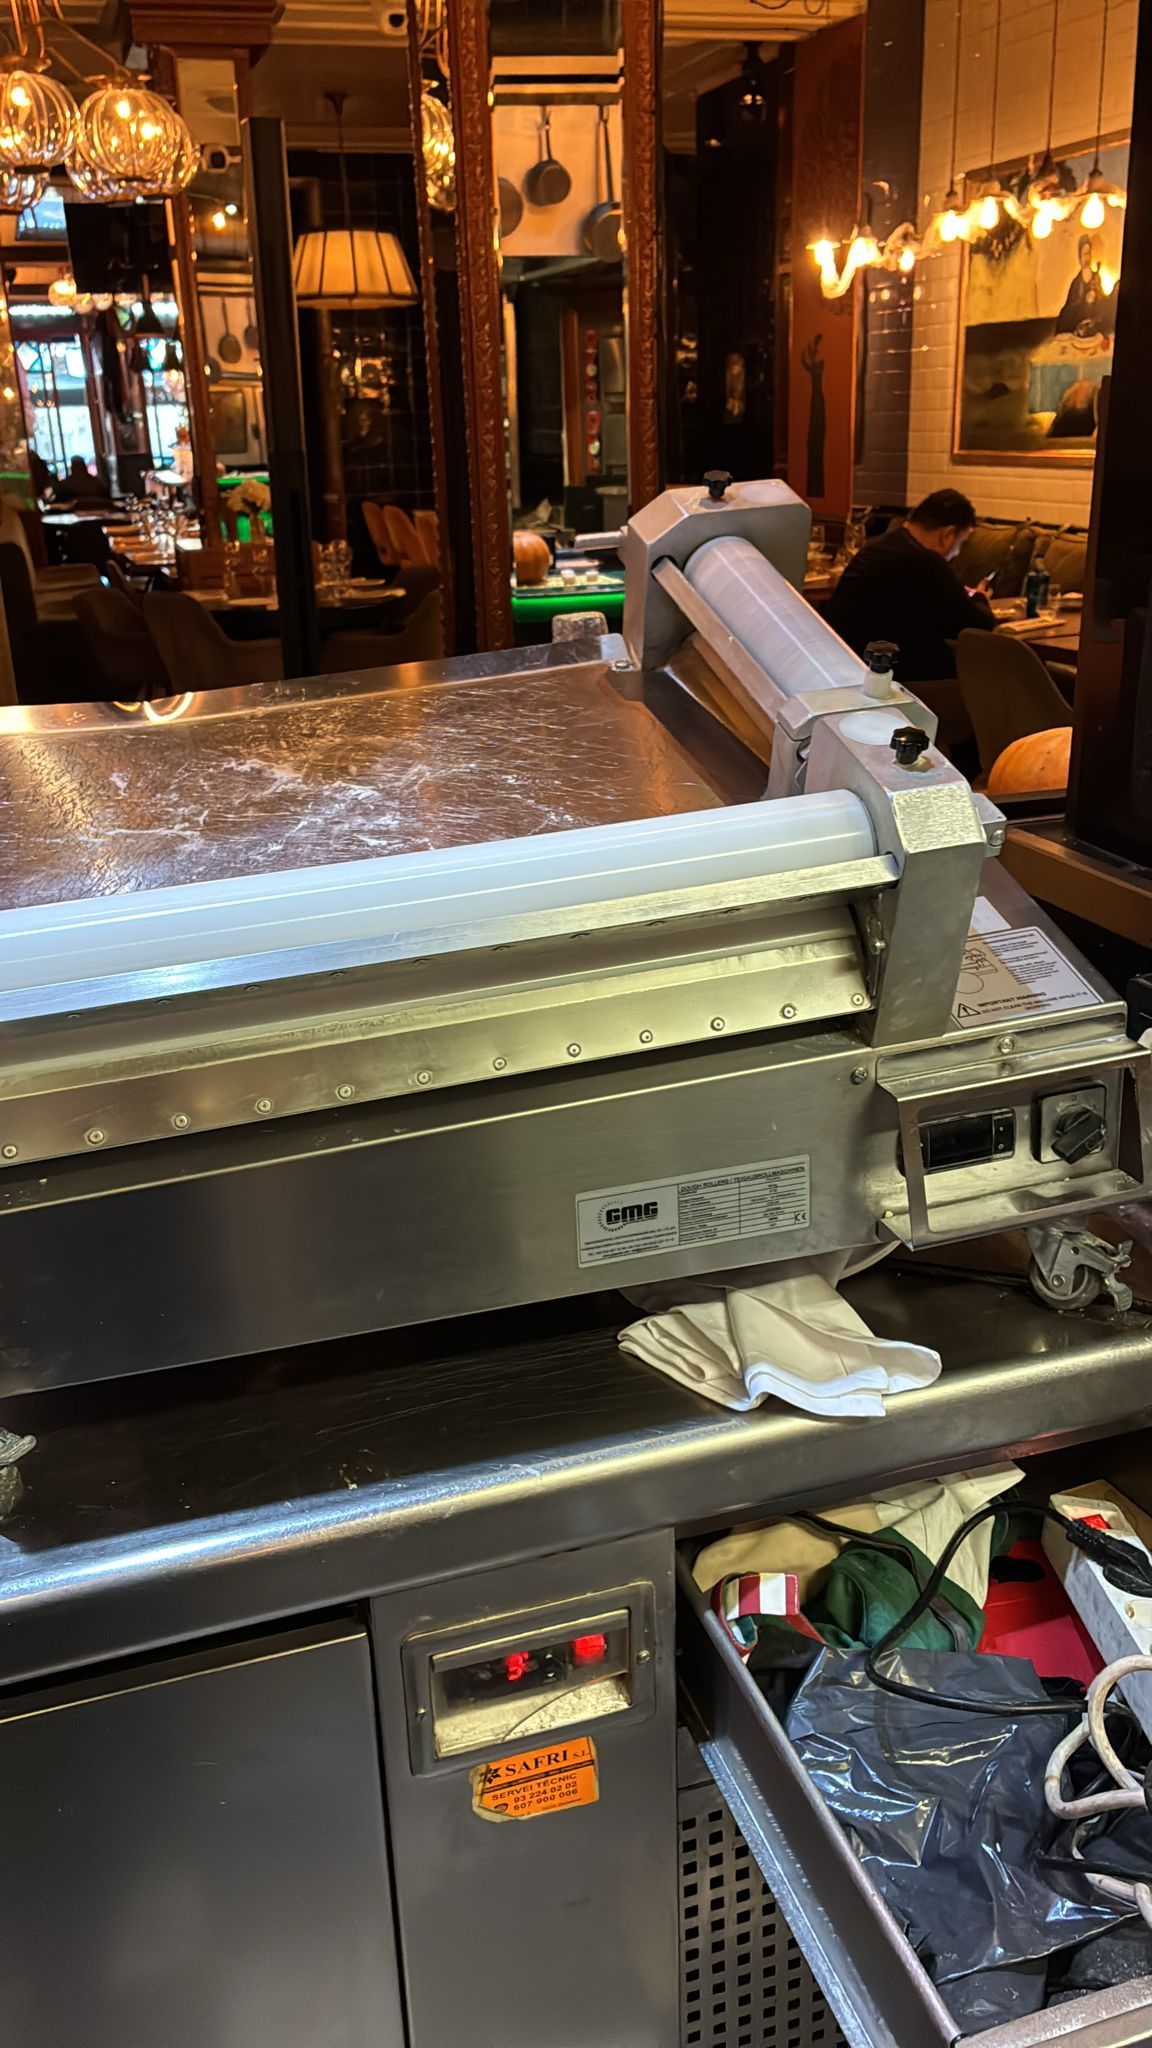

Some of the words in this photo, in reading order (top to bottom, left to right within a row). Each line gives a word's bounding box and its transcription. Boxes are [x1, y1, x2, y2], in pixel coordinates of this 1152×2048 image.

[606, 1201, 658, 1224] GMG
[504, 1749, 568, 1777] SAFRI
[491, 1785, 533, 1801] SERVEI
[513, 1794, 526, 1804] 93
[528, 1789, 547, 1800] 224
[550, 1784, 562, 1794] 02
[564, 1781, 577, 1790] 02
[513, 1800, 532, 1811] 607
[536, 1794, 556, 1804] 900
[558, 1788, 578, 1799] 006
